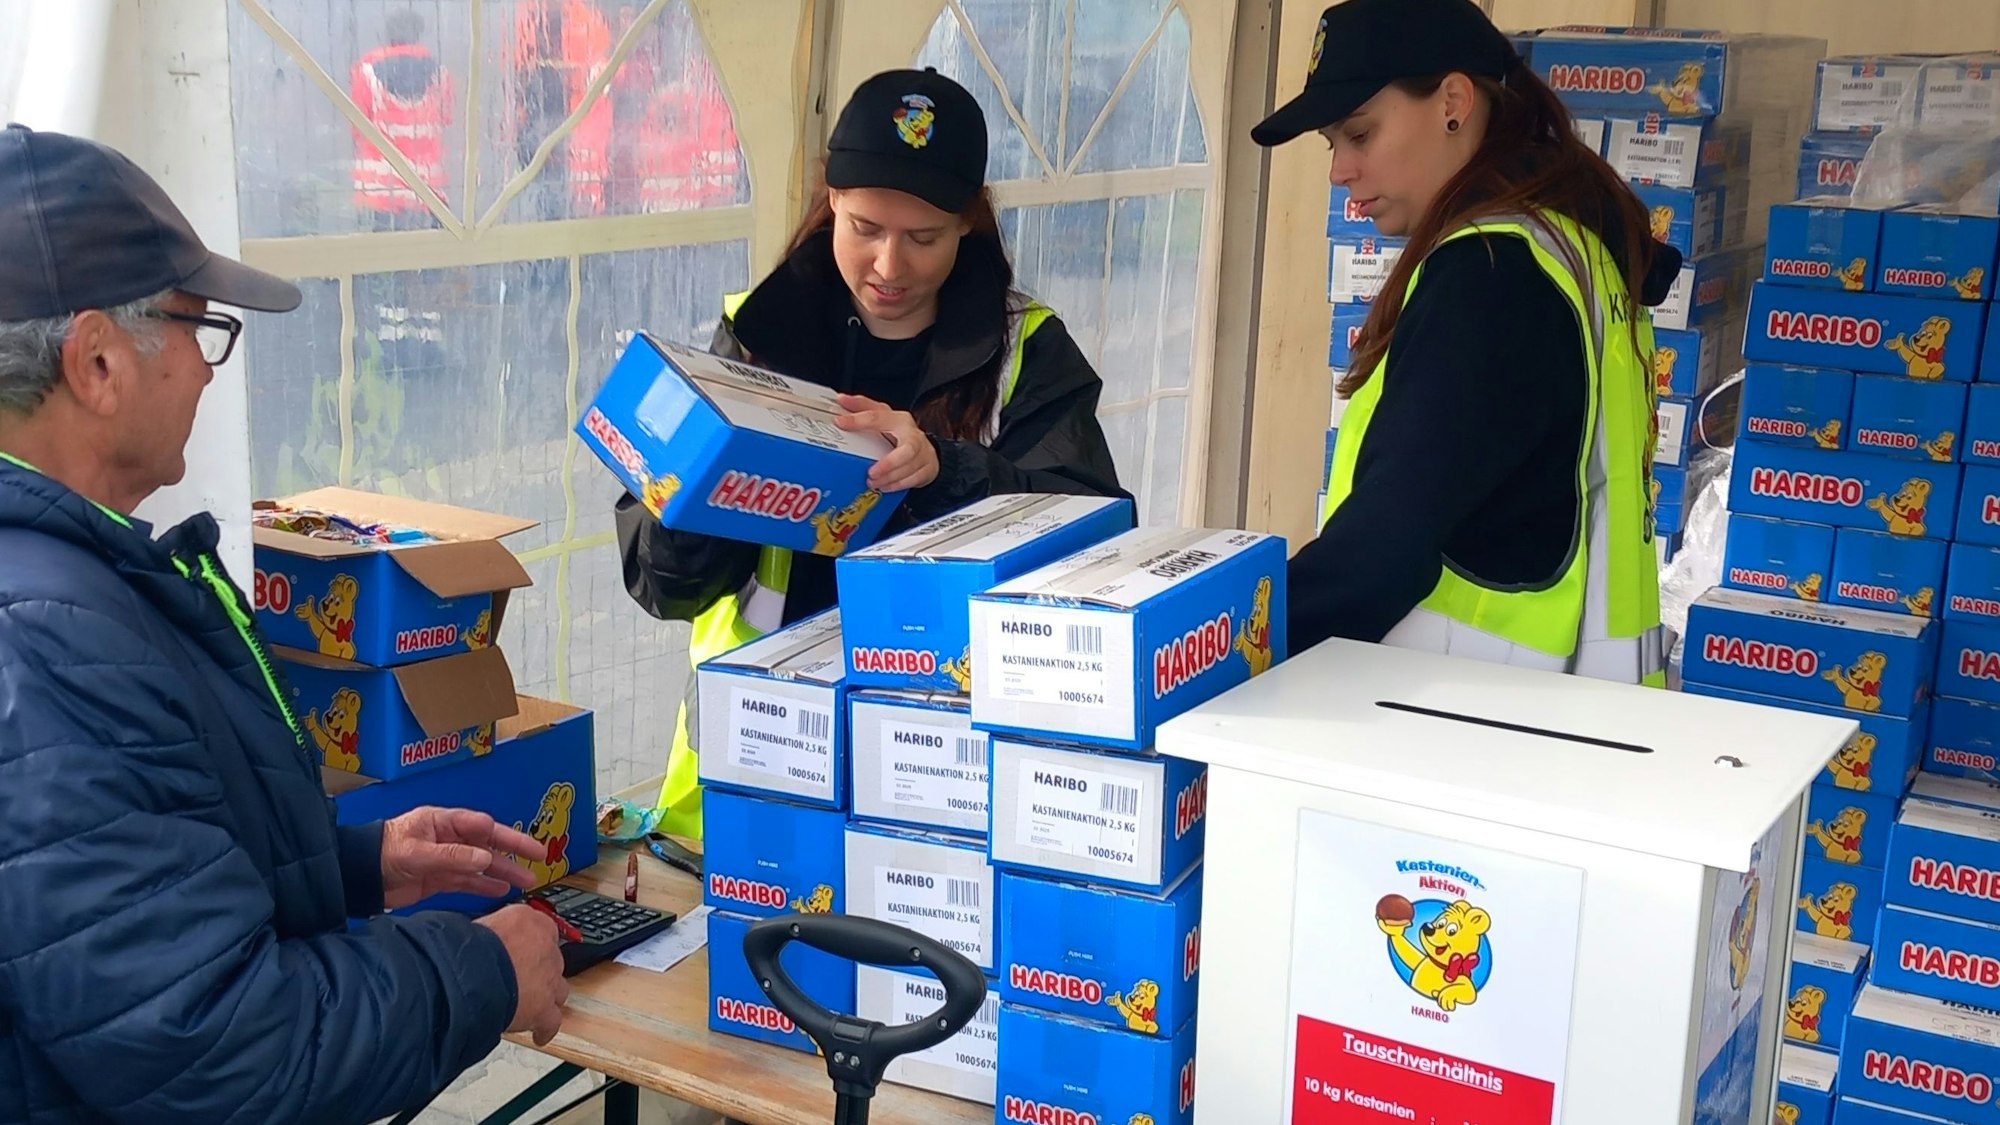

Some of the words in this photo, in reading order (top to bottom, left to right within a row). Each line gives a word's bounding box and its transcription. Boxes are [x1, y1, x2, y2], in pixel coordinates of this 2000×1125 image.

[1550, 65, 1645, 93] HARIBO
[1772, 258, 1830, 278] HARIBO
[1885, 268, 1946, 288] HARIBO
[1768, 311, 1882, 347] HARIBO
[1749, 417, 1806, 438] HARIBO
[1858, 429, 1918, 450] HARIBO
[707, 470, 822, 522] HARIBO
[1752, 467, 1863, 507] HARIBO
[1730, 568, 1788, 590] HARIBO
[1838, 581, 1897, 604] HARIBO
[1951, 596, 2000, 616] HARIB
[396, 623, 458, 653] HARIBO
[1001, 621, 1052, 637] HARIBO
[854, 648, 936, 674] HARIBO
[1002, 654, 1075, 669] KASTANIENAKTION
[1077, 661, 1089, 671] 2,5
[1092, 662, 1103, 672] KG
[1154, 610, 1232, 699] HARIBO
[1705, 634, 1818, 677] HARIBO
[742, 698, 787, 718] HARIBO
[1059, 691, 1104, 704] 10005674
[401, 732, 461, 766] HARIBO
[740, 728, 804, 749] KASTANIENAKTION
[805, 742, 816, 752] 2,5
[817, 745, 827, 755] KG
[894, 731, 943, 748] HARIBO
[1934, 747, 1995, 770] HARIBO
[787, 766, 826, 783] 10005674
[894, 762, 963, 779] KASTANIENAKTION
[1034, 771, 1088, 793] HARIBO
[947, 798, 988, 812] 10005674
[1032, 804, 1107, 827] KASTANIENAKTION
[1109, 820, 1121, 831] 2,5
[1124, 822, 1136, 833] KG
[1087, 846, 1134, 863] 10005674
[887, 872, 934, 889] HARIBO
[1396, 860, 1486, 890] Kastanien-
[1909, 857, 2000, 901] HARIB
[711, 874, 786, 908] HARIBO
[1419, 876, 1466, 897] Aktion
[888, 902, 955, 920] KASTANIENAKTION
[957, 912, 968, 922] 2,5
[970, 914, 980, 924] KG
[1901, 942, 2000, 987] HARIB
[906, 982, 947, 1001] HARIB
[1011, 964, 1102, 1004] HARIBO
[718, 997, 795, 1032] HARIBO
[1411, 1006, 1449, 1023] HARIBO
[974, 1028, 985, 1038] 2,5
[987, 1030, 997, 1041] KG
[955, 1052, 996, 1070] 10005674
[1343, 1032, 1503, 1092] Tauschverhältnis
[1864, 1050, 1992, 1103] HARIBO
[1304, 1077, 1319, 1092] 10
[1323, 1082, 1341, 1101] kg
[1344, 1090, 1416, 1119] Kastanien
